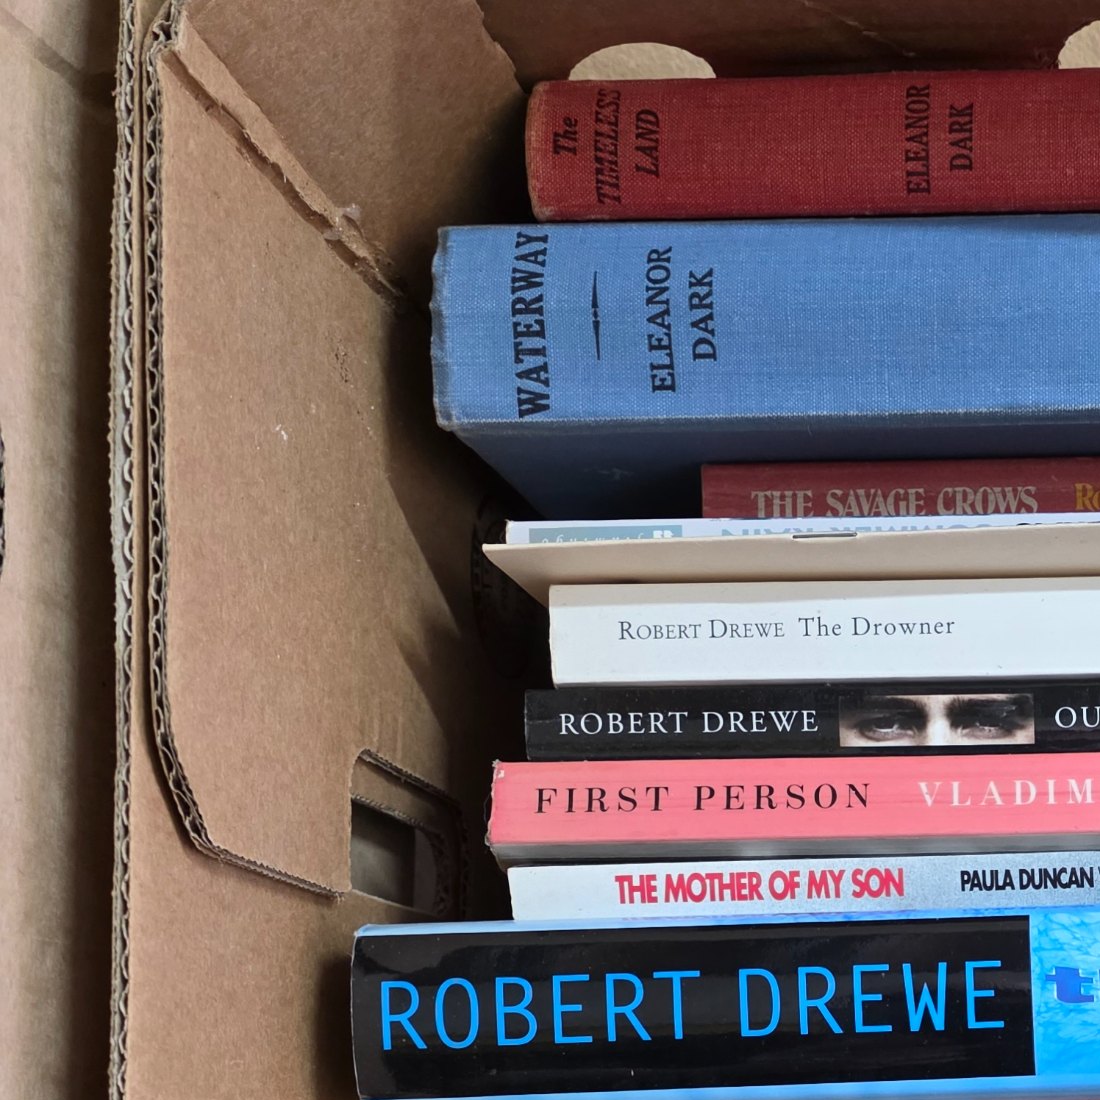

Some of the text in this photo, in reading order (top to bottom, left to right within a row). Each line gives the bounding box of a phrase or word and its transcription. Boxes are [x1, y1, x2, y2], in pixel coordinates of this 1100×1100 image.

[552, 115, 578, 156] The
[595, 89, 622, 204] TIMELESS
[636, 108, 661, 178] LAND
[907, 83, 931, 196] ELEANOR
[950, 101, 974, 172] DARK
[511, 231, 550, 418] WATERWAY
[646, 246, 676, 393] ELEANOR
[689, 267, 717, 362] DARK
[751, 490, 813, 518] THE
[826, 488, 926, 517] SAVAGE
[937, 486, 1039, 515] CROWS
[619, 616, 956, 641] ROBERT DREWE The Drowner
[559, 712, 688, 736] ROBERT
[702, 709, 819, 734] DREWE
[535, 787, 670, 815] FIRST
[694, 783, 871, 811] PERSON
[615, 874, 658, 904] THE
[664, 871, 763, 902] MOTHER
[769, 870, 801, 900] OF
[807, 869, 846, 899] MY
[852, 867, 904, 898] SON
[960, 868, 1015, 893] PAULA
[1019, 866, 1094, 889] DUNCAN
[381, 960, 1005, 1051] ROBERT DREWE
